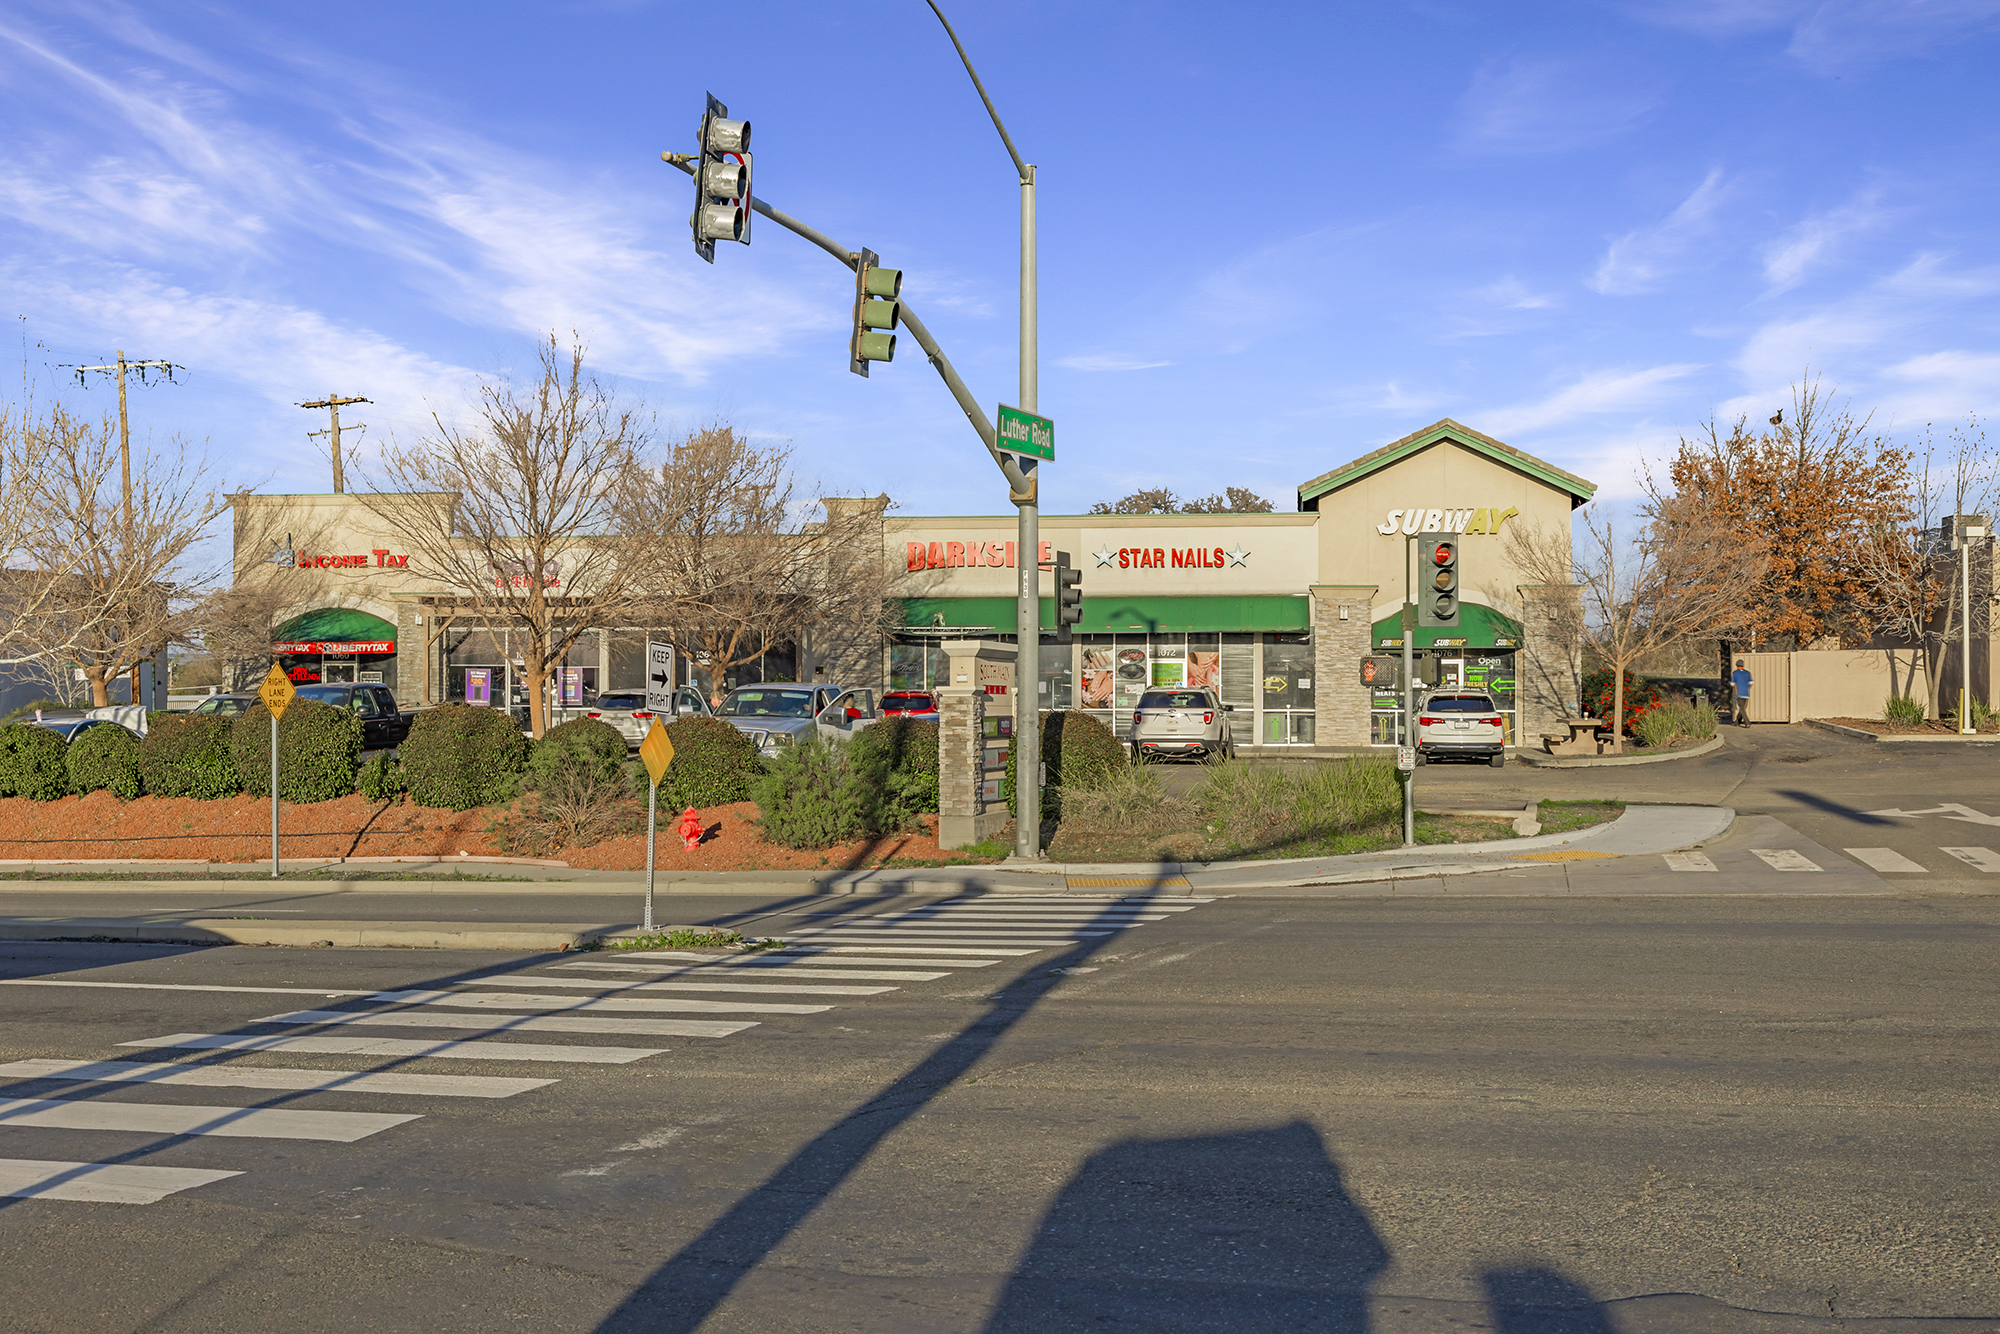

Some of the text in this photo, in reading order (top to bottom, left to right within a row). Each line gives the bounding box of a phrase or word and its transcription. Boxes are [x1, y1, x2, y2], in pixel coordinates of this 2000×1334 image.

[1001, 414, 1051, 448] Luther Road
[1376, 506, 1519, 536] SUBWAY
[907, 541, 1052, 572] DARKSIE
[1118, 548, 1225, 568] STAR NAILS
[1381, 639, 1404, 647] SUBWAY
[1434, 638, 1466, 647] SUBWAY
[1495, 638, 1516, 647] SUBWAY
[652, 649, 670, 664] KEEP
[1118, 650, 1144, 661] Open
[1157, 649, 1176, 657] 1072
[1433, 649, 1453, 658] 1076
[1478, 657, 1501, 666] Open
[293, 667, 308, 675] OPEN
[267, 677, 286, 686] RIGHT
[269, 688, 286, 697] LANE
[269, 699, 286, 708] ENDS
[649, 692, 669, 708] RIGHT
